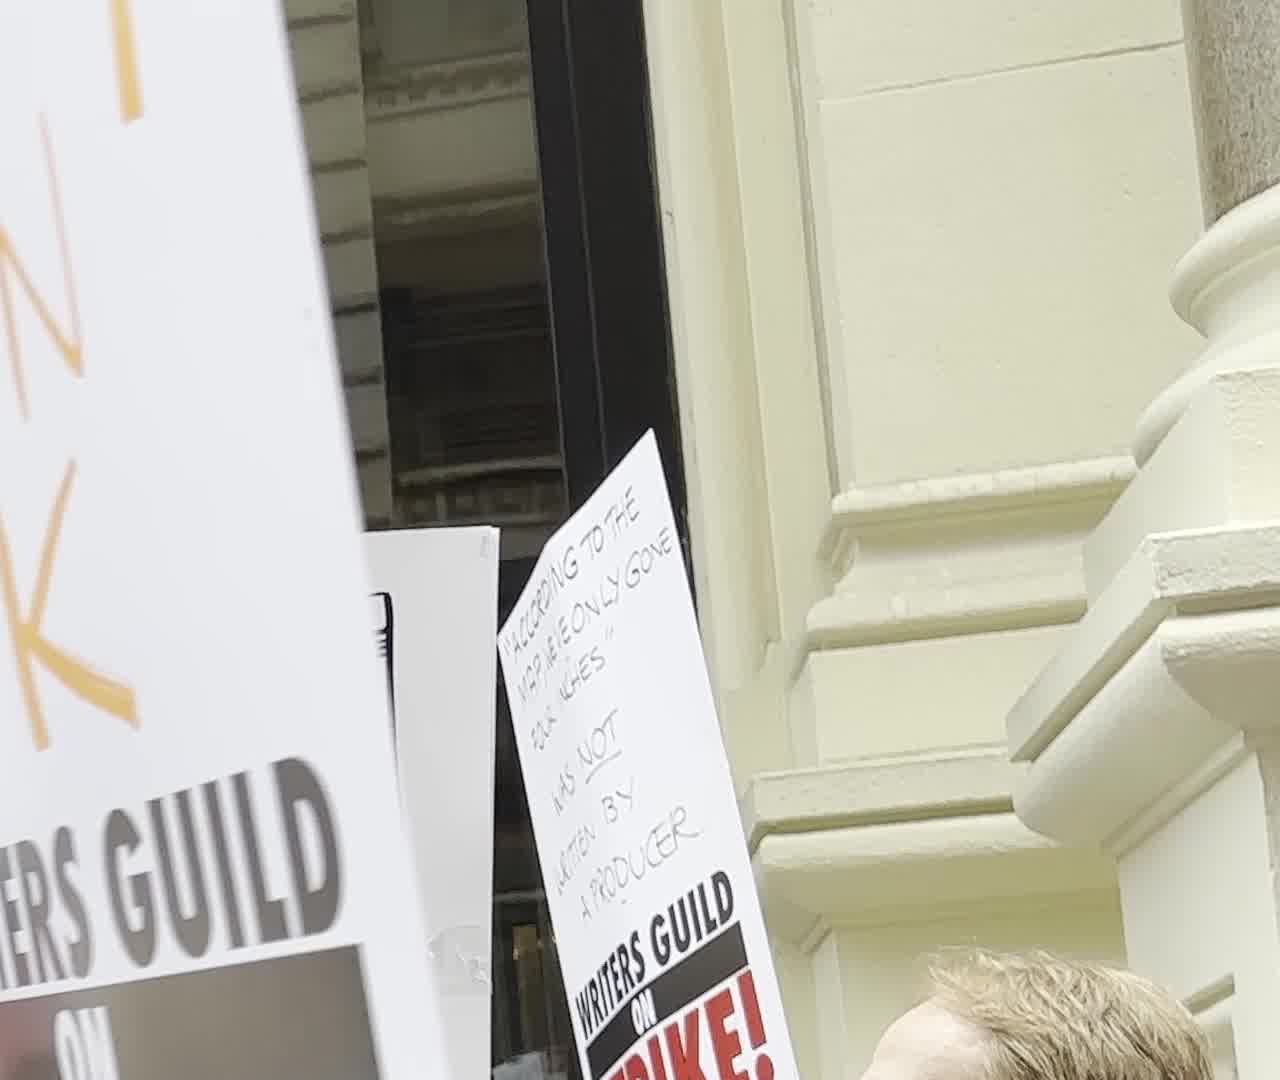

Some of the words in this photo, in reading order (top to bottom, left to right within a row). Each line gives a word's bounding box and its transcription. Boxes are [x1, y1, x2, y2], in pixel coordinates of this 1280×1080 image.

[580, 525, 604, 561] TO
[605, 484, 640, 540] THE
[572, 569, 622, 634] ONLY
[625, 527, 674, 589] GONE
[576, 707, 619, 767] NOT
[601, 774, 635, 825] BY
[100, 756, 345, 968] GUILD
[576, 930, 645, 1039] WRITERS
[649, 870, 734, 966] GUILD
[630, 987, 658, 1037] ON
